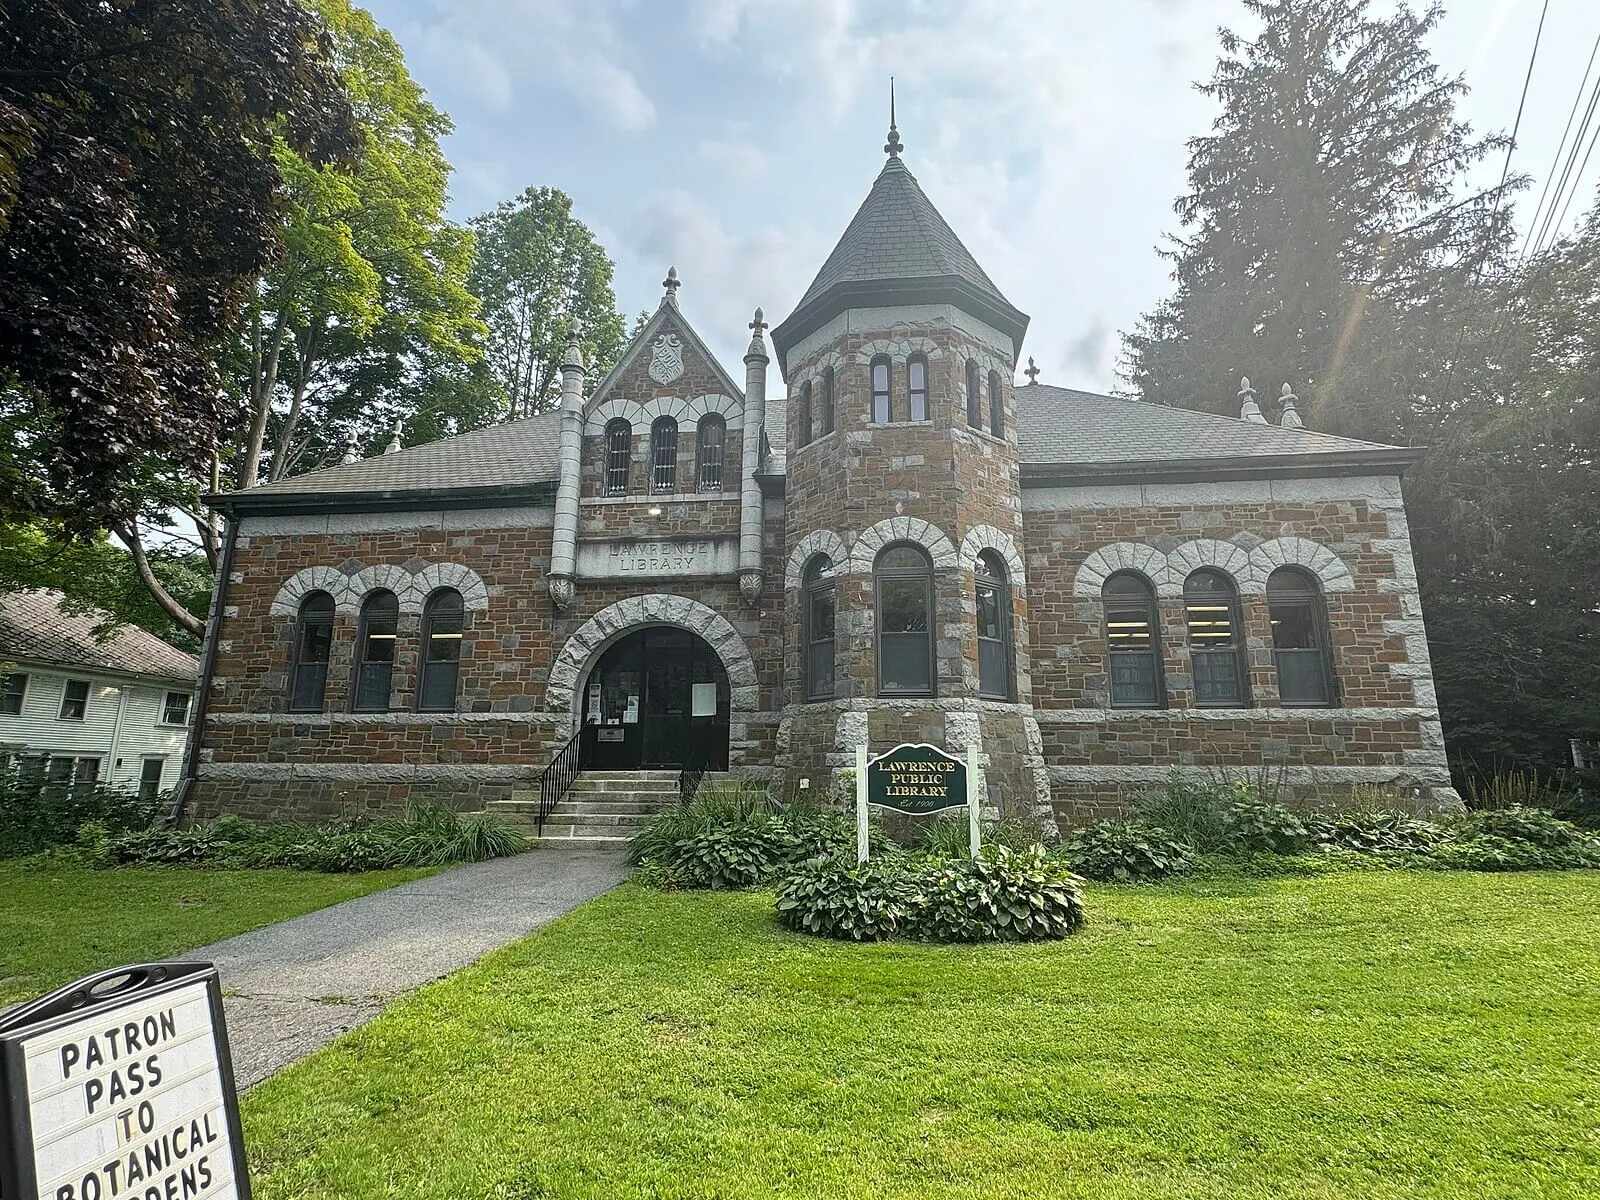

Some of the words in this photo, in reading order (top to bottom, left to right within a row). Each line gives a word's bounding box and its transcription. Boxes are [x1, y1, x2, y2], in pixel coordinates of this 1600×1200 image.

[610, 542, 708, 556] LAWRENCE
[620, 557, 694, 571] LIBRARY
[878, 761, 955, 772] LAWRENCE
[891, 774, 943, 784] PUBLIC
[886, 786, 949, 796] LIBRARY
[61, 1008, 176, 1079] PATRON
[85, 1054, 162, 1114] PASS
[117, 1100, 155, 1142] TO
